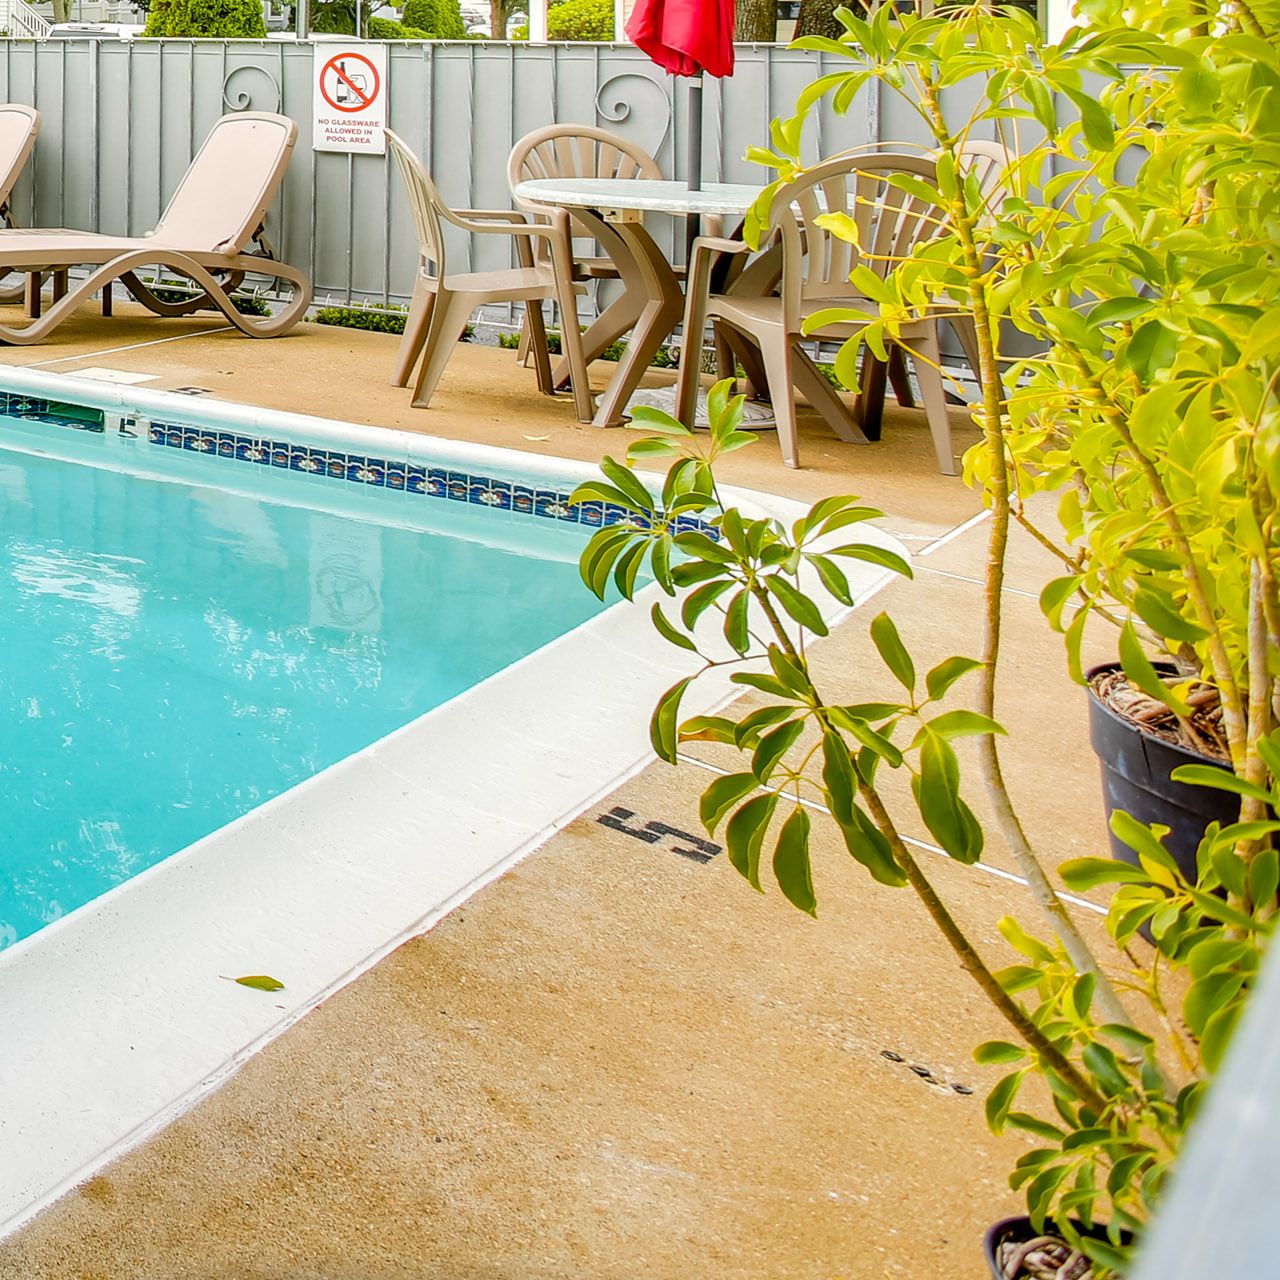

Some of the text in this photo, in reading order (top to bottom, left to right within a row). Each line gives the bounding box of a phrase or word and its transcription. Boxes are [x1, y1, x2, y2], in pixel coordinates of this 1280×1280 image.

[331, 119, 380, 127] GLASSWARE
[325, 127, 362, 135] ALLOWED
[326, 135, 371, 144] POOL AREA
